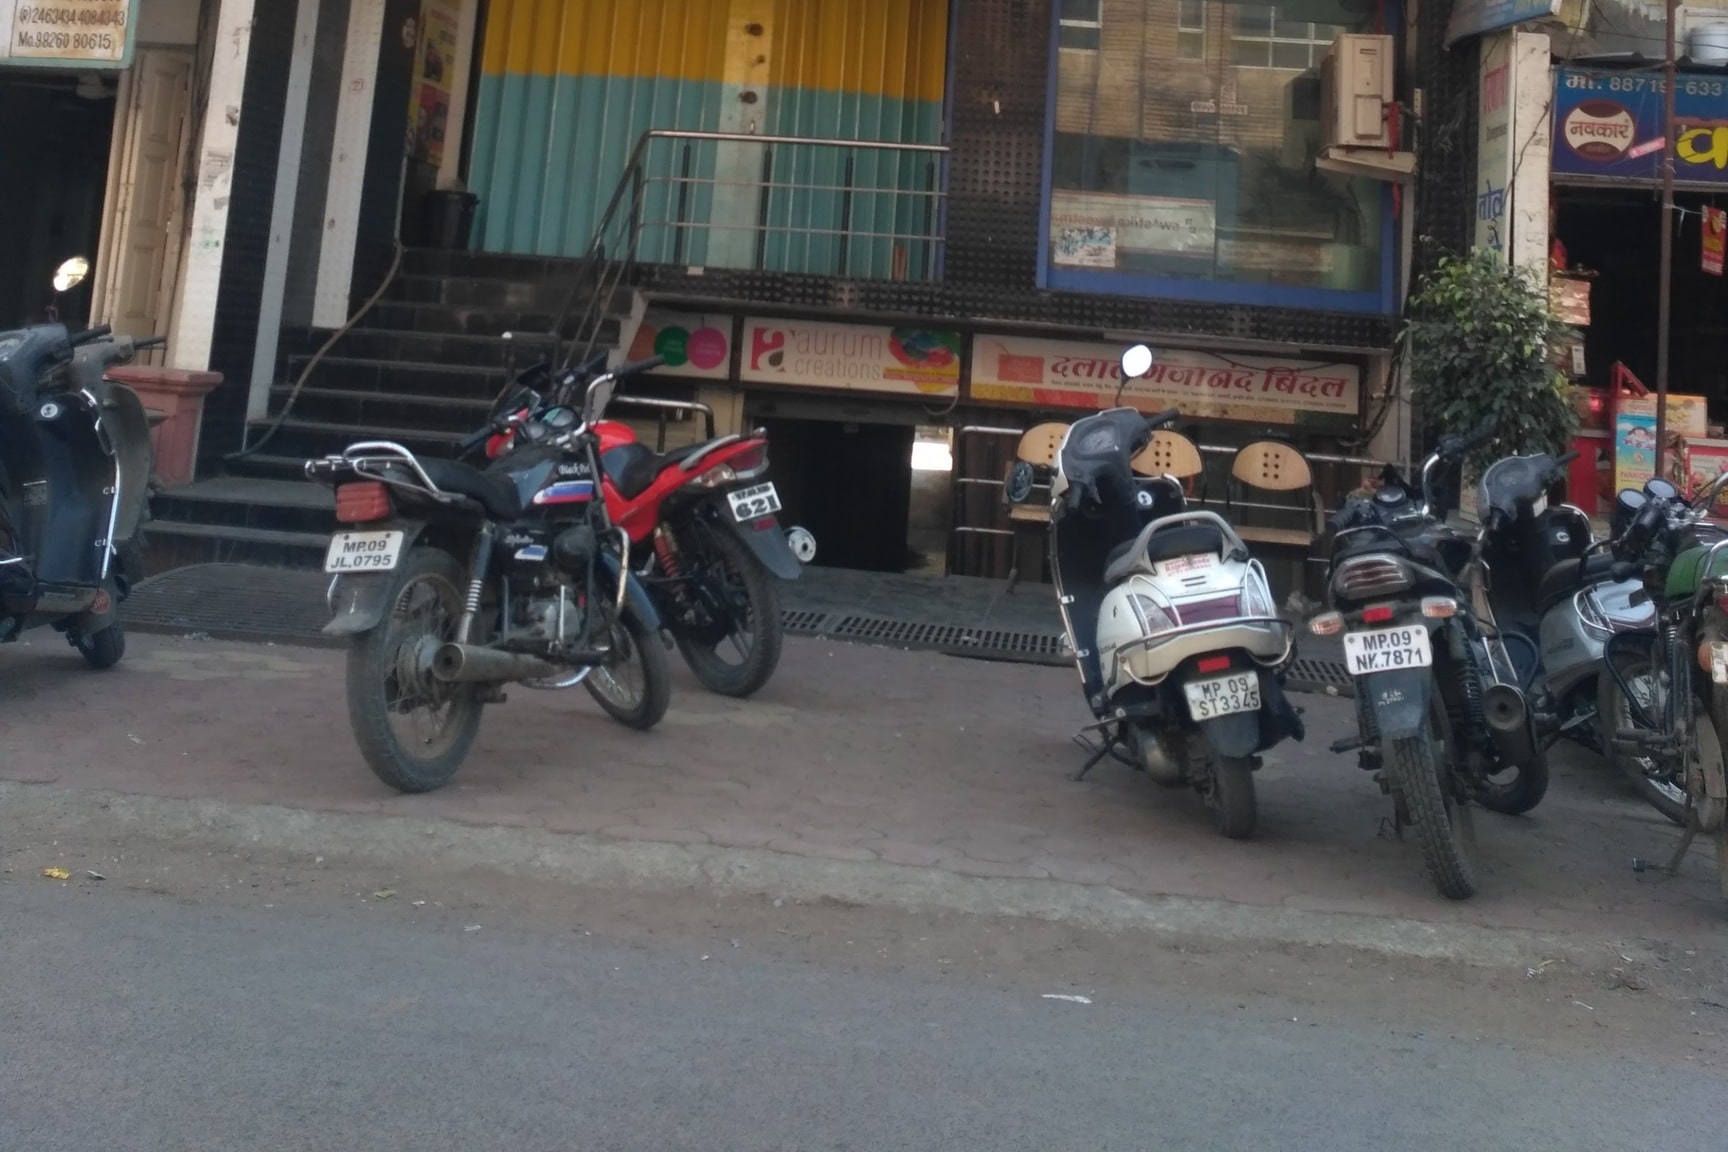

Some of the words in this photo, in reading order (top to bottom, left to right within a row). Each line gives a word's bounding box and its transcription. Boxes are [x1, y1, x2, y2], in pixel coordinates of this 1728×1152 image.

[73, 32, 112, 50] 80615
[795, 328, 882, 361] aurum
[794, 356, 881, 381] creations
[735, 493, 779, 519] 621
[342, 540, 388, 554] MP.09
[1362, 630, 1412, 651] MP.09
[1201, 681, 1221, 699] MP
[1227, 677, 1249, 694] 09
